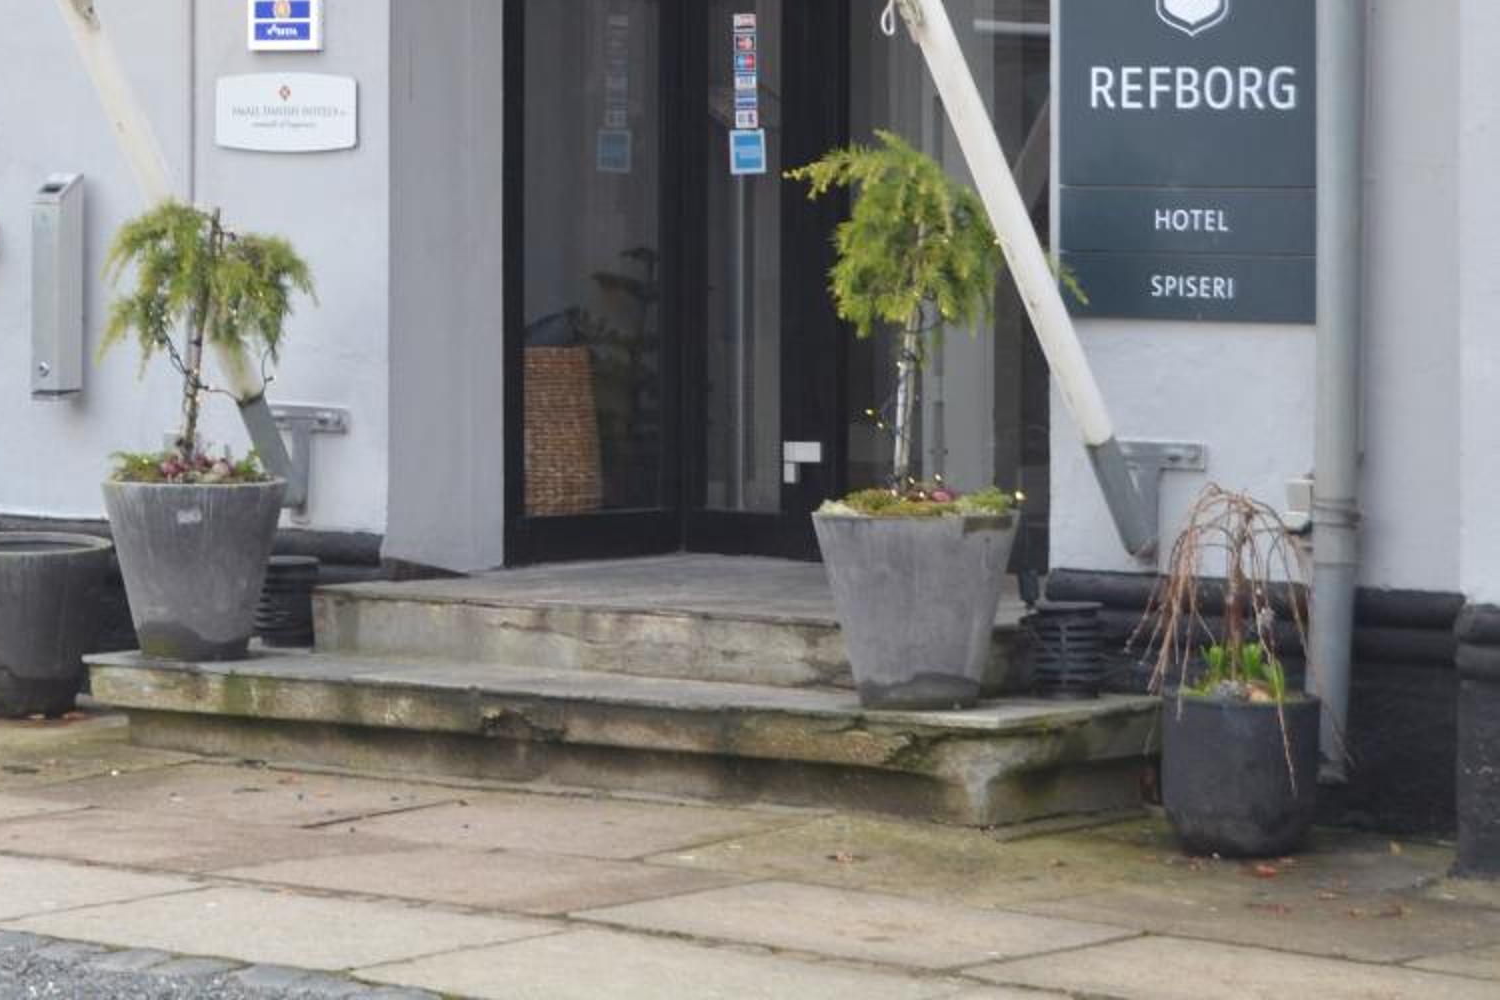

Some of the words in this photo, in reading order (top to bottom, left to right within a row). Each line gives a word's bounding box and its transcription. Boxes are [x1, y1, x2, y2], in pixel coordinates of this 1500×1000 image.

[1090, 65, 1297, 110] REFBORG
[1154, 209, 1229, 232] HOTEL
[1150, 274, 1234, 299] SPISERI
